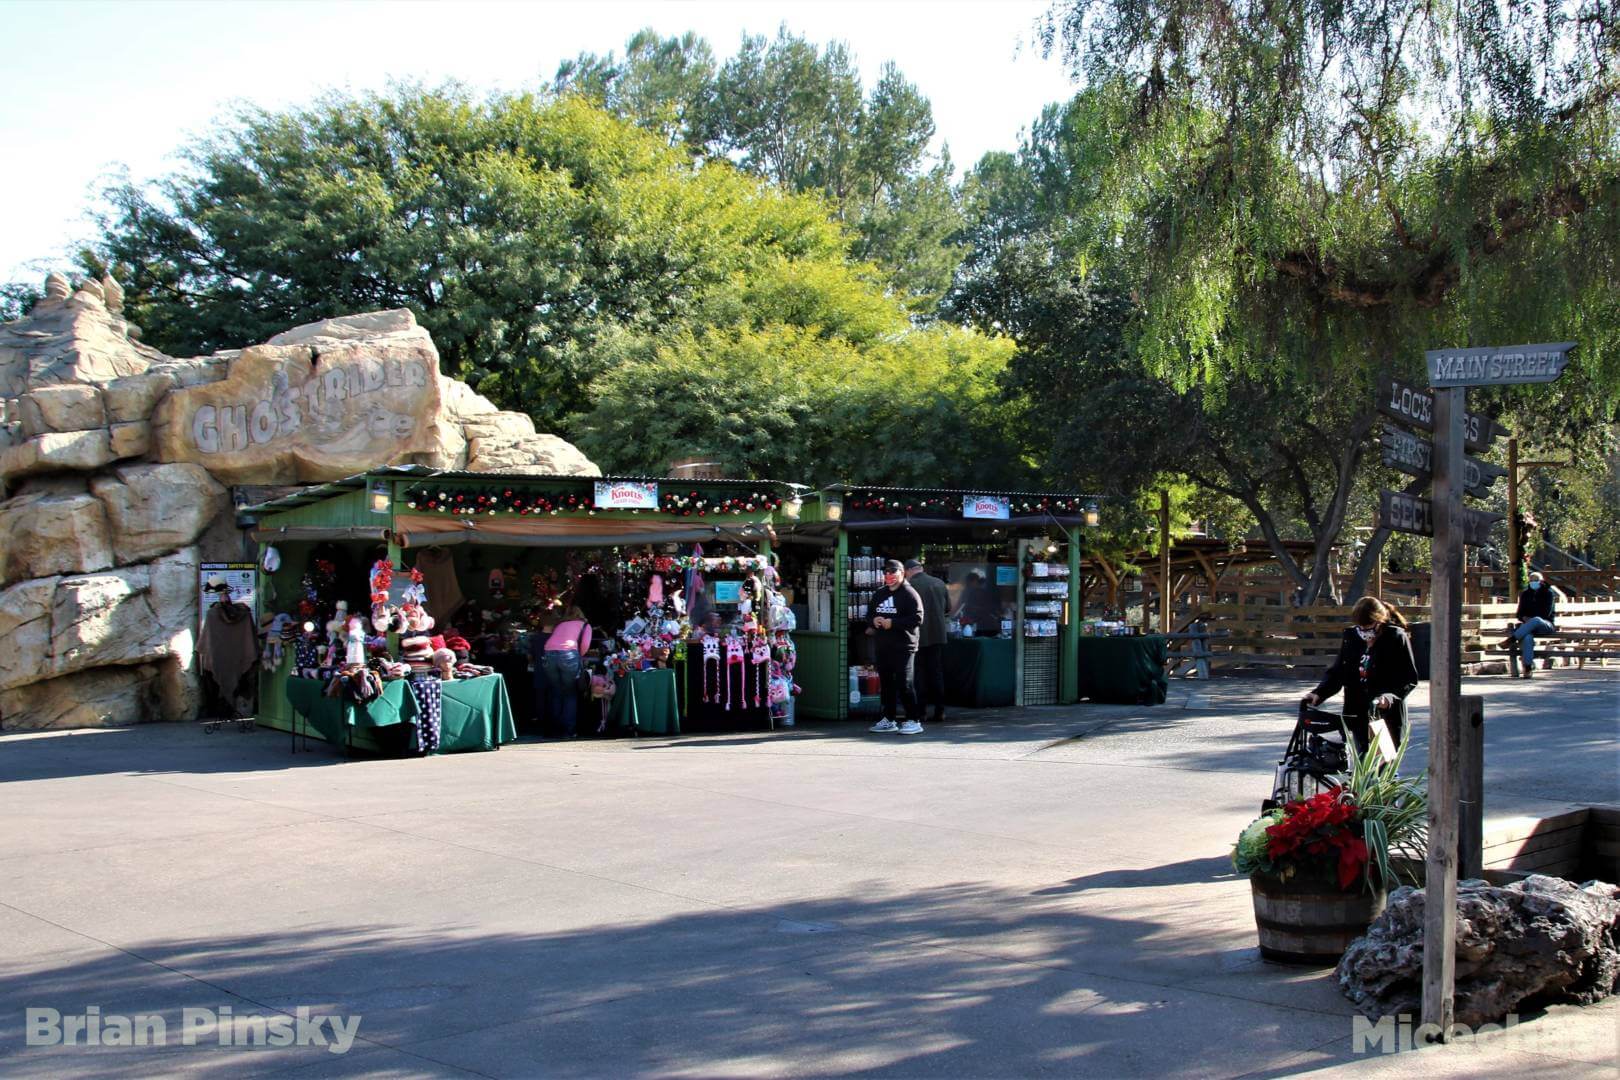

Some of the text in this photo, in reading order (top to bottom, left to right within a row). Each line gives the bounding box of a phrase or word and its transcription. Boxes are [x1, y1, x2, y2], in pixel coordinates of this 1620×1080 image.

[1434, 351, 1560, 380] MAIN STREET
[192, 361, 425, 453] GHOSTRIDER
[1390, 382, 1480, 442] LOCKRS
[1391, 432, 1433, 472] FIRST
